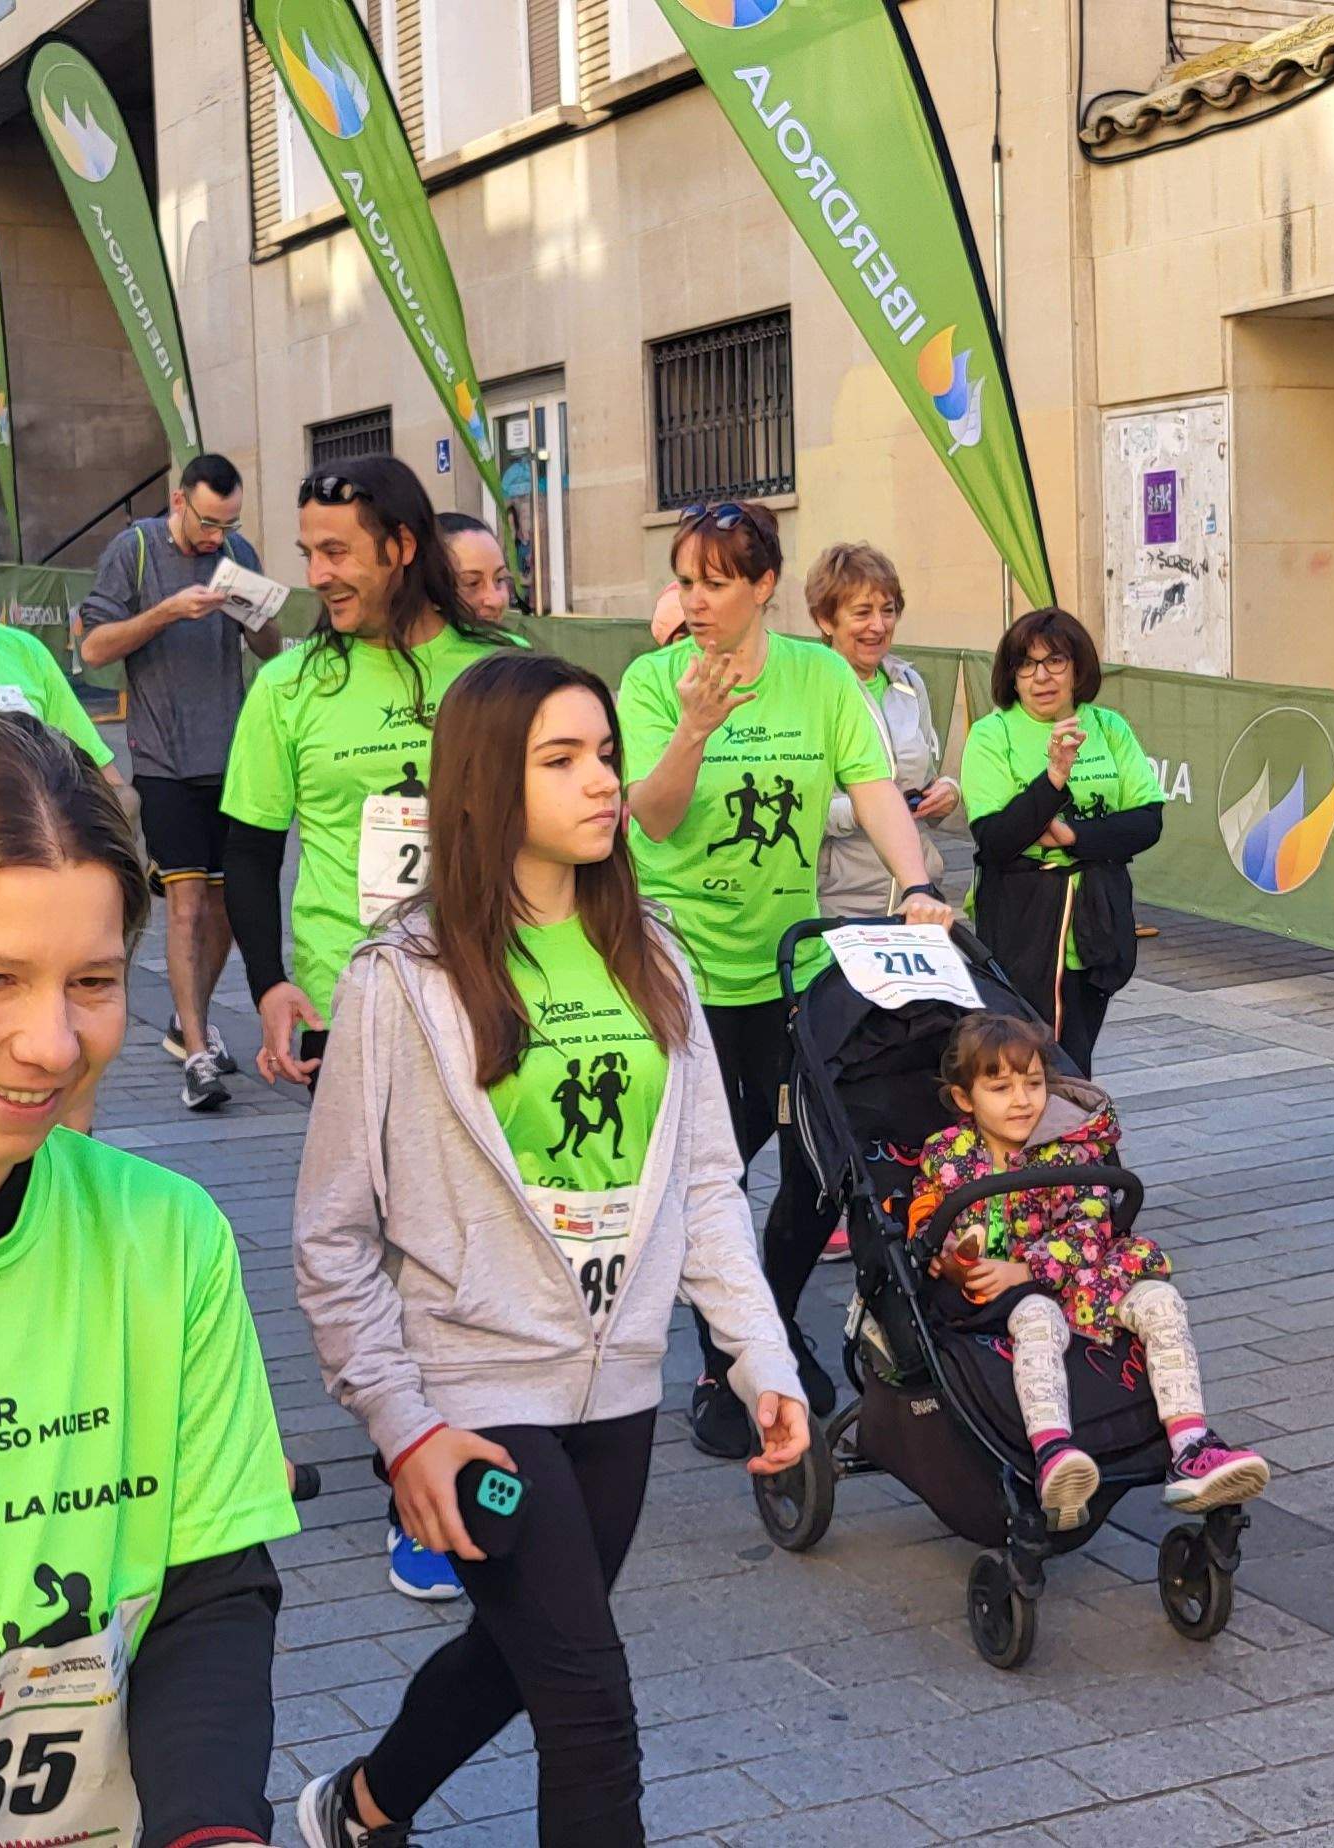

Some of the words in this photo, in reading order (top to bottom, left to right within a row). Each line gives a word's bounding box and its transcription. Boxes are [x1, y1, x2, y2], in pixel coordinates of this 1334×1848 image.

[736, 726, 767, 739] TOUR
[334, 750, 349, 761] EN
[353, 742, 398, 757] FORMA
[402, 740, 427, 750] POR
[779, 753, 825, 761] IGUALDAD
[874, 951, 937, 976] 274
[549, 1001, 584, 1015] TOUR
[560, 1035, 583, 1045] POR
[585, 1034, 600, 1043] LA
[601, 1032, 648, 1042] IGUALDA
[4, 1495, 46, 1524] LA
